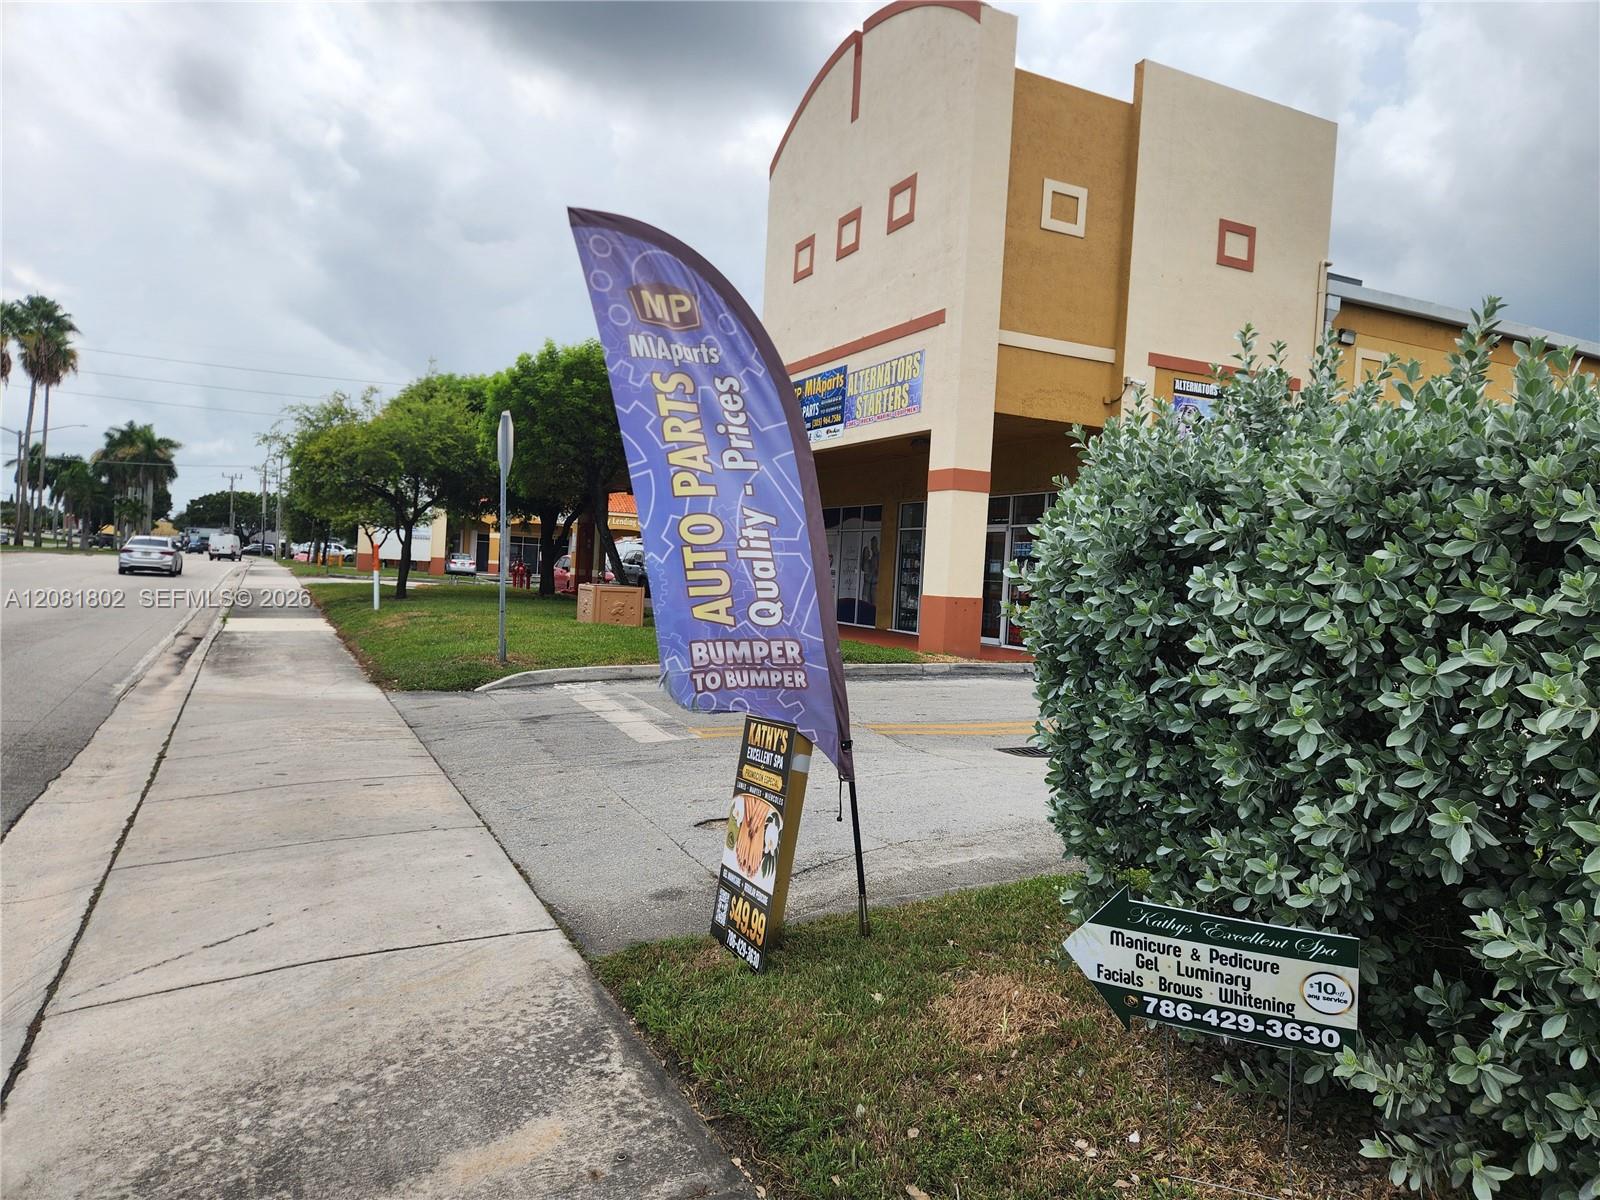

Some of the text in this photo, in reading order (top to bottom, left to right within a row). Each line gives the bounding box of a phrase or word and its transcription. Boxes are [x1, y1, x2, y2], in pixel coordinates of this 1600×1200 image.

[640, 290, 692, 323] MP
[628, 334, 720, 366] MIAparts
[847, 352, 921, 397] ALTERNATORS
[1175, 379, 1218, 396] ALTERNATORS
[802, 403, 819, 418] PARTS
[856, 383, 909, 419] STARTERS
[713, 376, 759, 471] Prices
[652, 371, 736, 627] AUTO PARTS
[736, 504, 783, 627] Quality
[690, 641, 803, 667] BUMPER
[692, 671, 807, 691] TO BUMPER
[748, 722, 788, 754] KATHY'S
[747, 746, 784, 770] EXCELLENT SPA
[729, 894, 767, 946] $49.99
[1110, 930, 1280, 975] Manicure & Pedicure
[1200, 920, 1289, 949] Excellent
[1294, 937, 1339, 959] Spa
[1097, 963, 1296, 1019] Facials Brows Whitening
[1136, 953, 1251, 992] Gel Luminary
[1322, 996, 1348, 1004] service
[1142, 996, 1341, 1048] 786-429-3630
